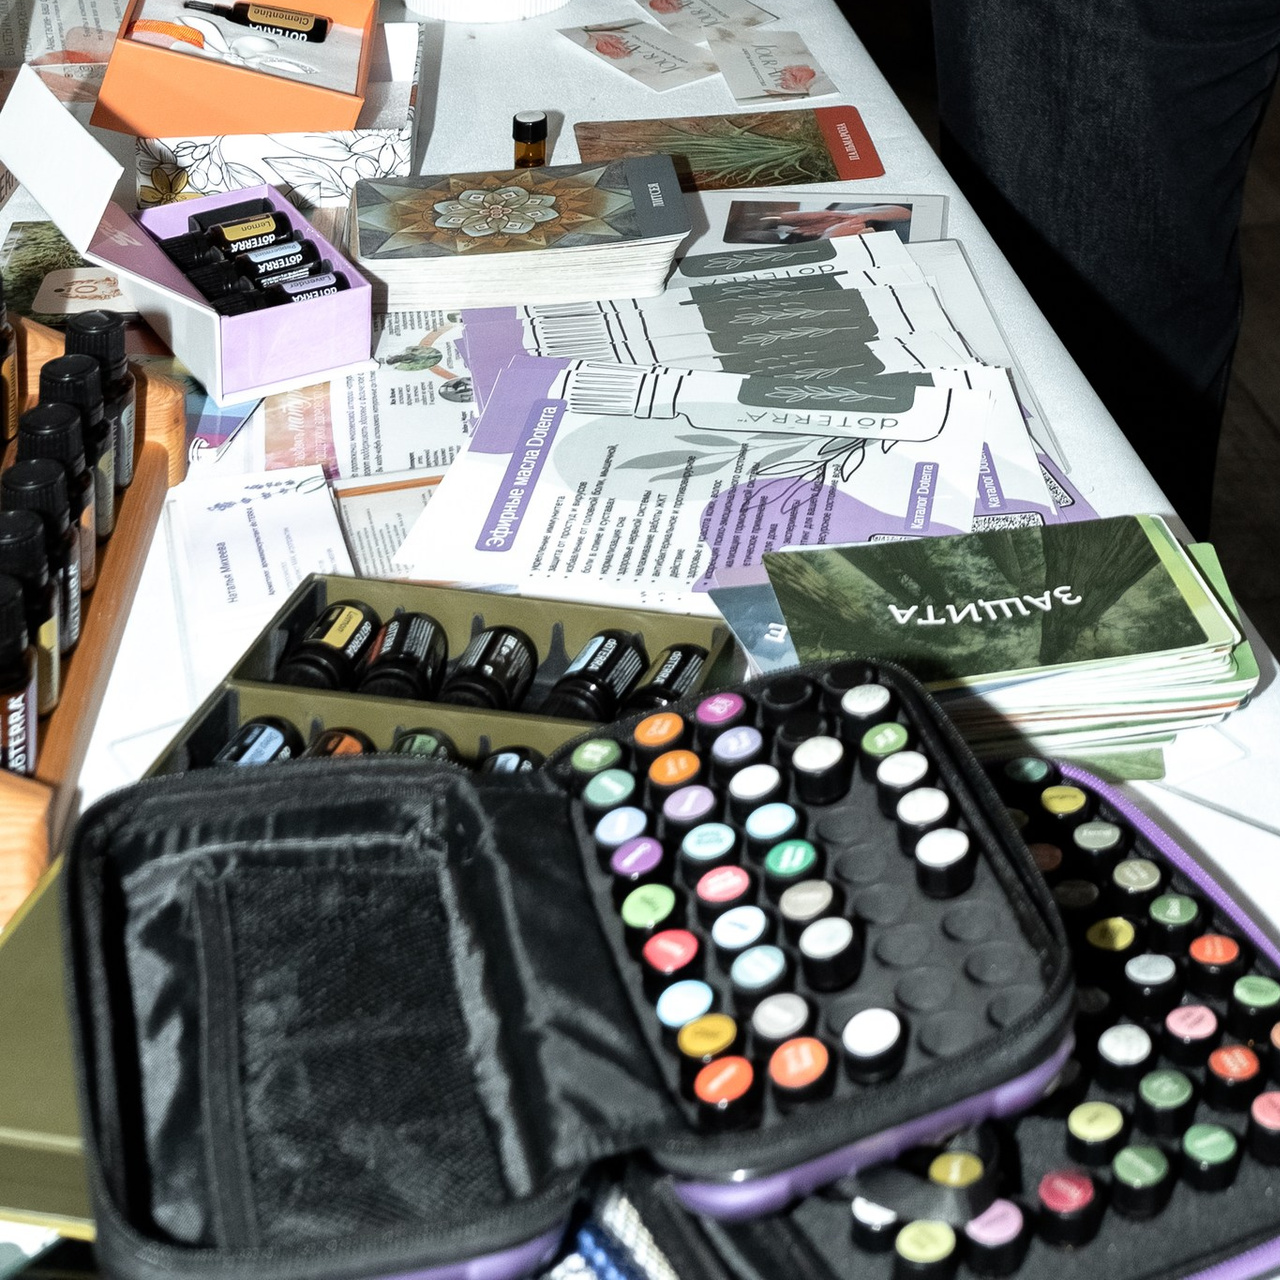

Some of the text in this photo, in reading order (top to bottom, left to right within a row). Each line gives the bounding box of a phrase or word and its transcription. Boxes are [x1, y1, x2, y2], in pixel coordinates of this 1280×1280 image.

[252, 6, 309, 26] Clementine
[240, 220, 271, 232] Lemon
[484, 405, 557, 547] Эфирные масла Doterra
[910, 464, 933, 528] Каталог Doterra
[982, 475, 1000, 507] Каталог
[214, 541, 238, 603] Наталья Михеева
[886, 583, 1083, 630] ЗАЩИТА
